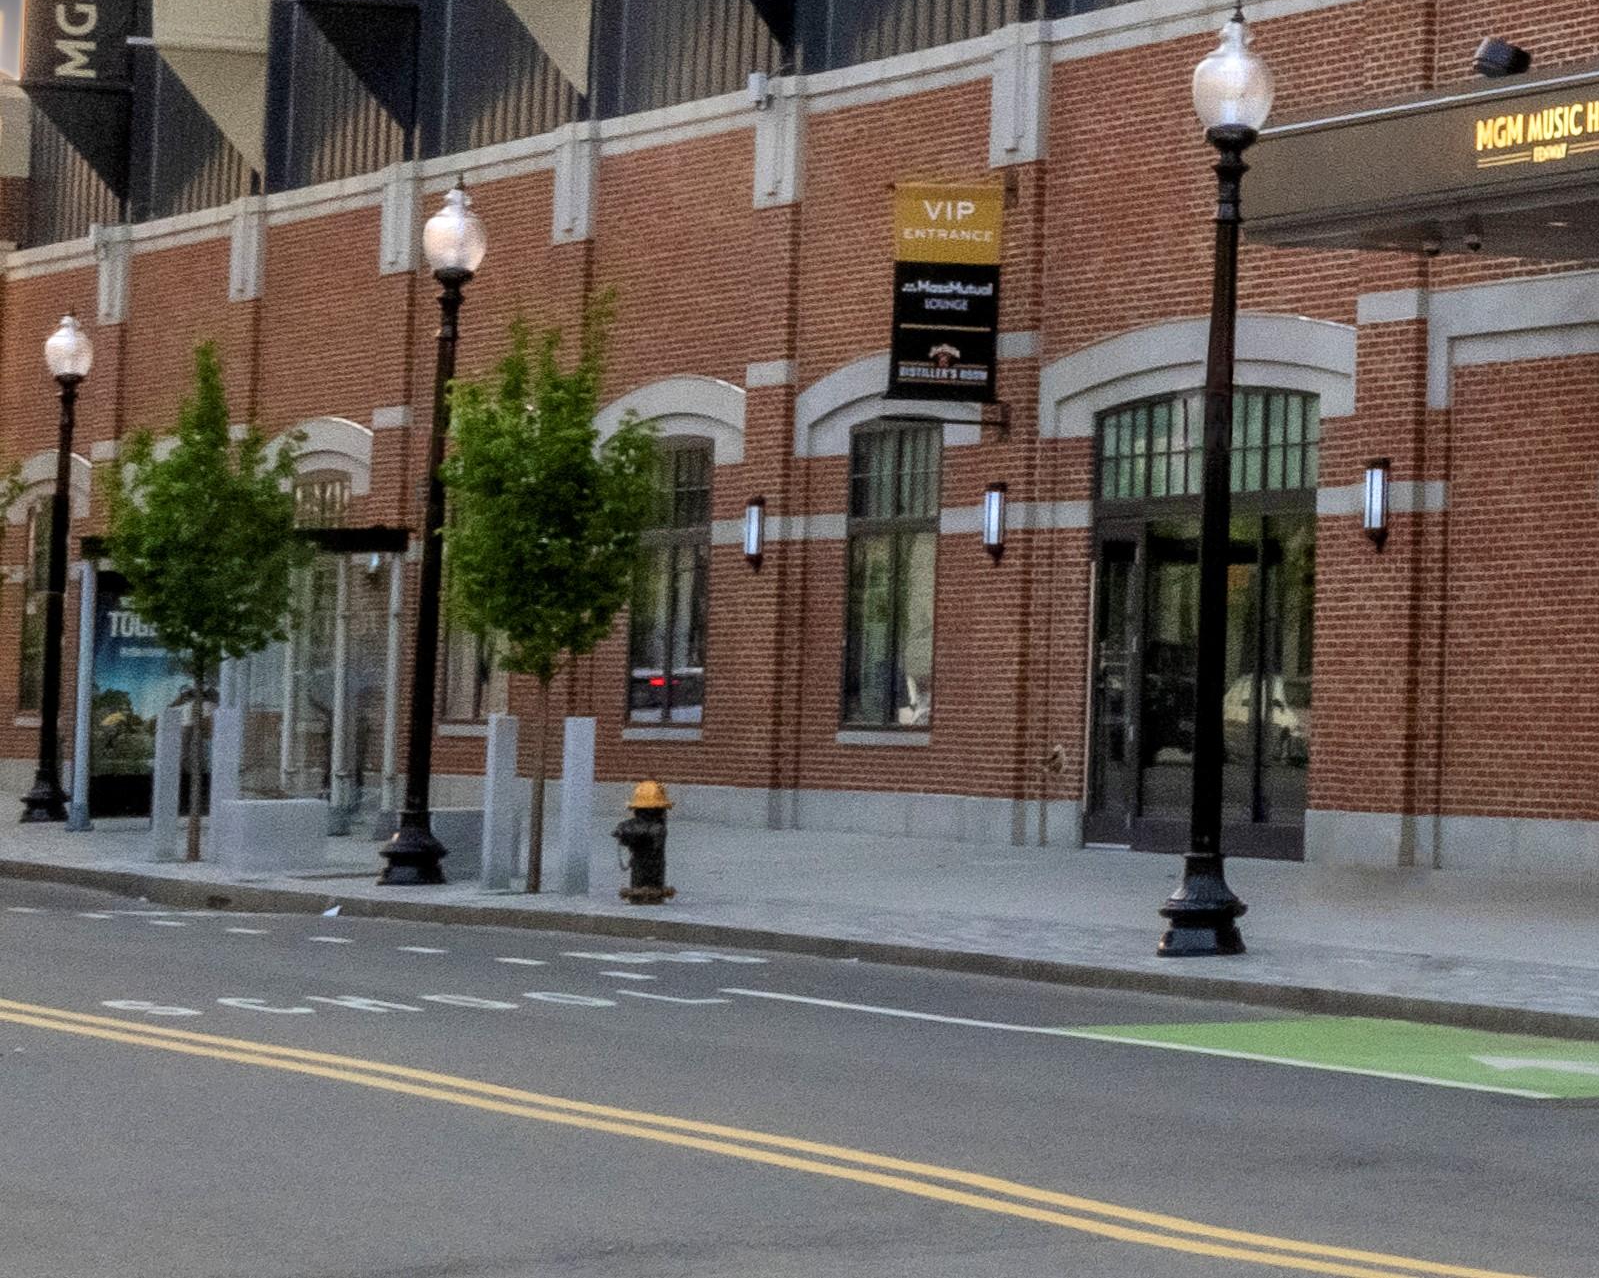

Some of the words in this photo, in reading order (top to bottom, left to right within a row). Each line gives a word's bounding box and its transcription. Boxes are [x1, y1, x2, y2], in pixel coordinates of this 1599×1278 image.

[1475, 114, 1524, 151] MGM
[1527, 103, 1584, 142] MUSIC
[923, 199, 976, 221] VIP
[902, 227, 994, 243] ENTRANCE
[917, 280, 994, 296] MassMutual
